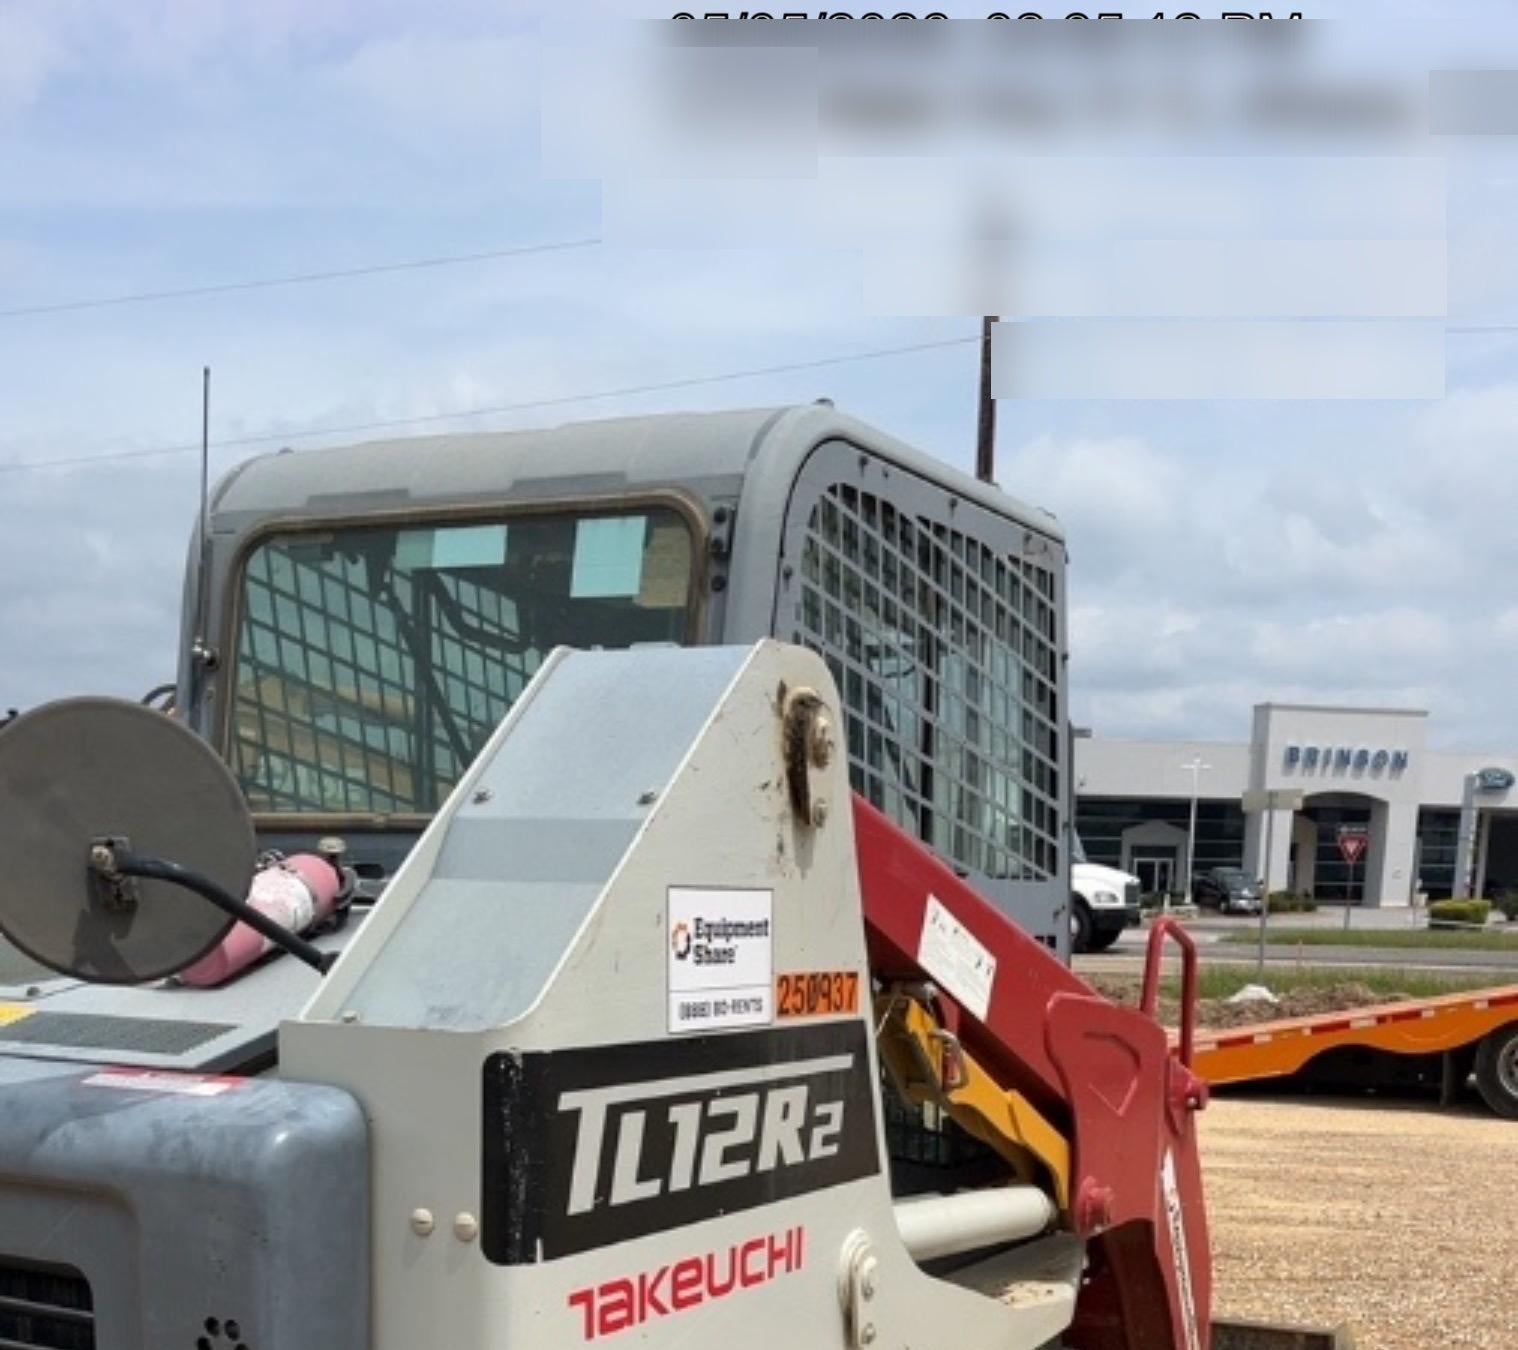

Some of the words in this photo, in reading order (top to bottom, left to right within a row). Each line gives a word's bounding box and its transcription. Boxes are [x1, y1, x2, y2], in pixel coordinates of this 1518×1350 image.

[1282, 745, 1409, 770] BRINSON
[693, 916, 769, 943] Equipment
[692, 944, 736, 966] Share
[777, 972, 858, 1017] 250937
